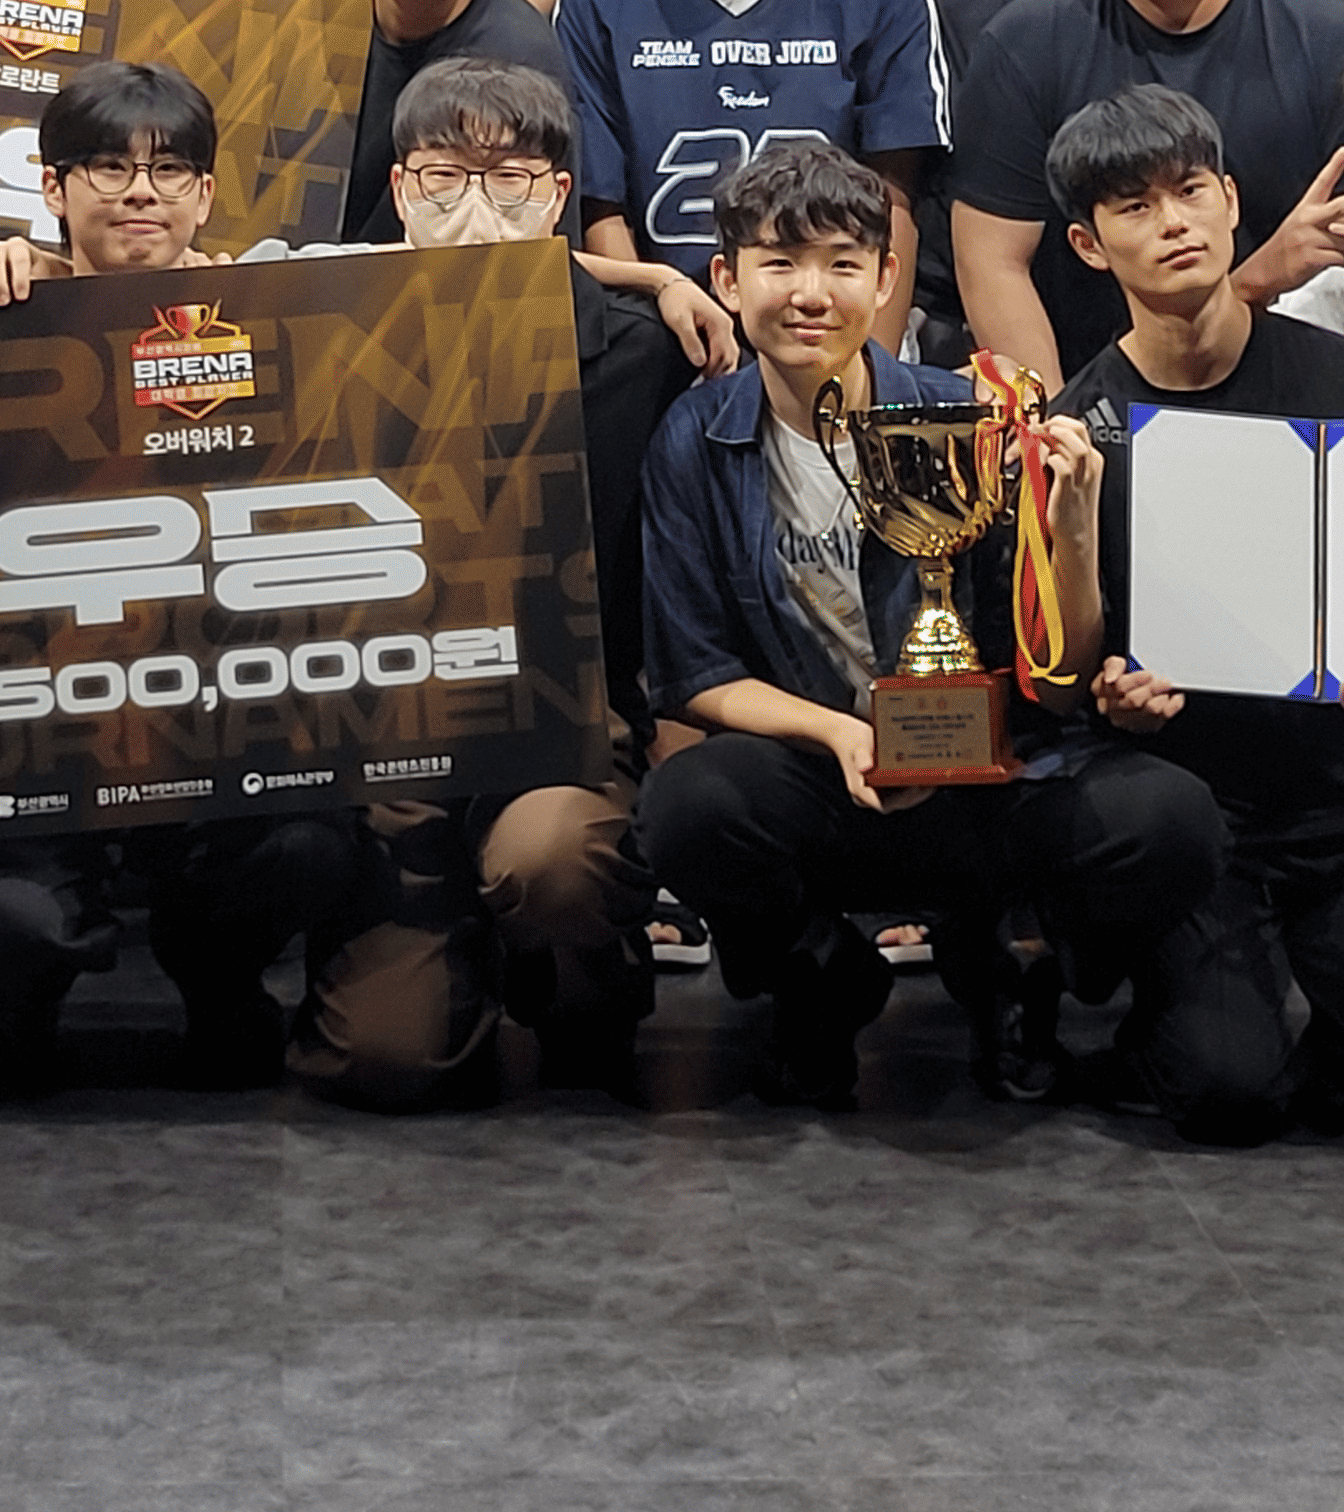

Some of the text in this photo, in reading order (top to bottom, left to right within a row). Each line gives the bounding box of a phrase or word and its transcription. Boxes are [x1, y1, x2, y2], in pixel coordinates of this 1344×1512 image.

[640, 40, 693, 54] TEAM
[711, 40, 771, 65] OVER
[133, 352, 253, 379] BRENA
[135, 371, 253, 388] BEST PLAYER
[143, 424, 255, 455] 오버워치 2
[96, 785, 141, 806] BIPA
